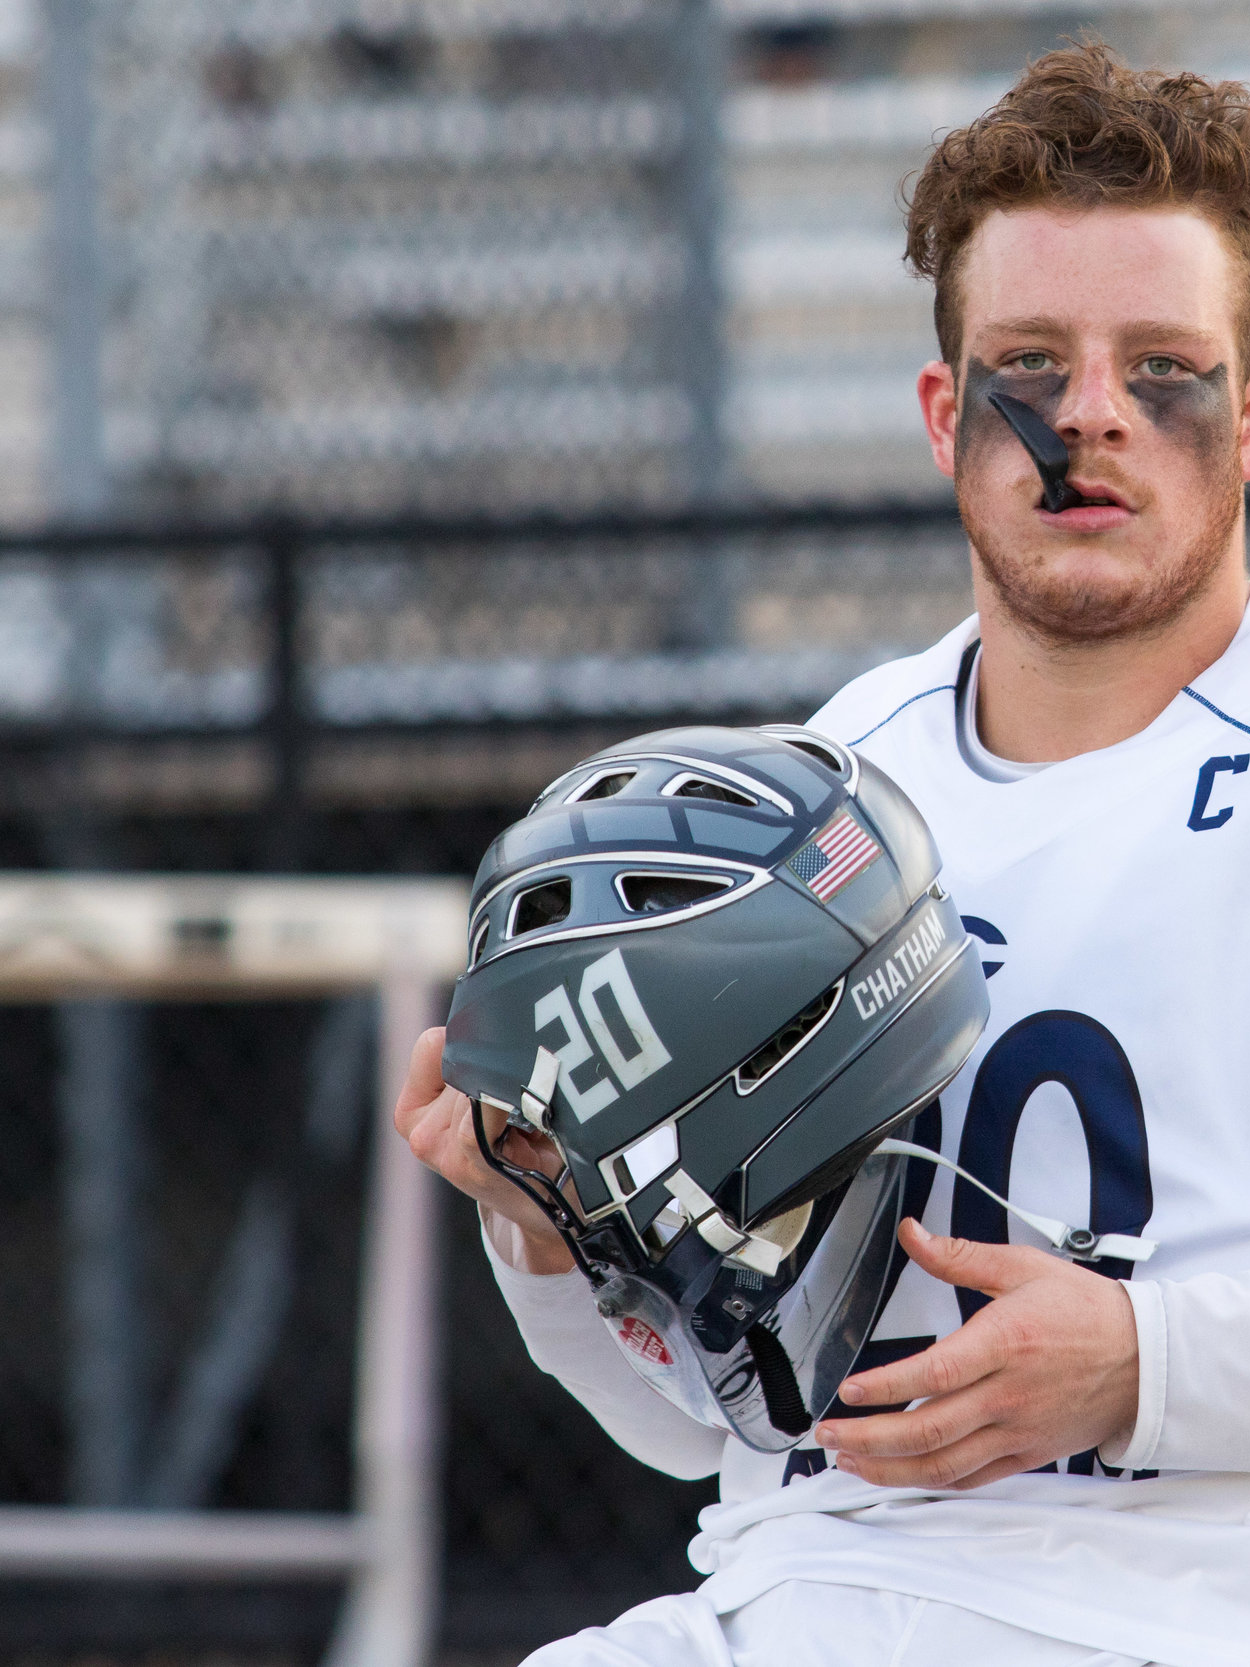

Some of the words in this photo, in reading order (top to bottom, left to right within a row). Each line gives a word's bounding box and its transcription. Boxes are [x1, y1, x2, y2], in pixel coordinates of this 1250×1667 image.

[1187, 753, 1250, 832] C
[850, 907, 946, 1020] CHATHAM
[534, 947, 672, 1125] 20
